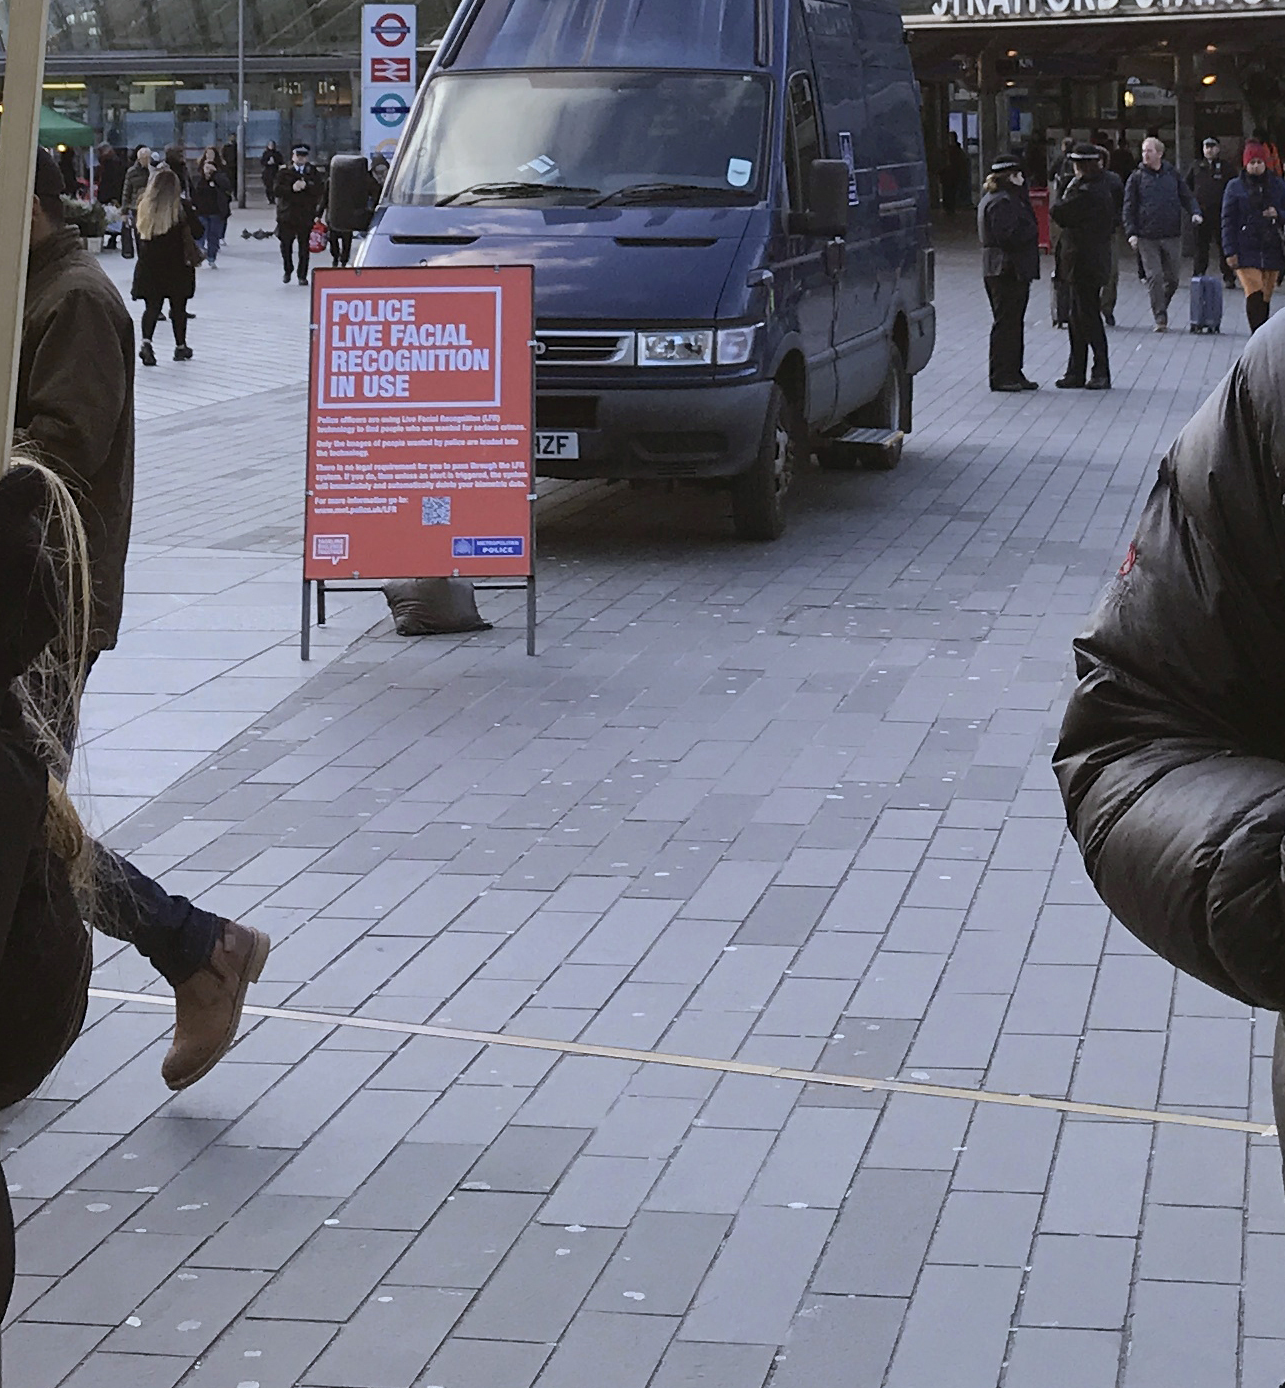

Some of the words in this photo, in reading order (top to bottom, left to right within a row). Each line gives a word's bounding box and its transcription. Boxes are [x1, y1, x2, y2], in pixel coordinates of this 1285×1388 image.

[332, 299, 416, 323] POLICE
[332, 324, 383, 348] LIVE
[390, 323, 473, 347] FACIAL
[331, 348, 490, 373] RECOGNITION
[330, 375, 355, 398] IN
[363, 374, 410, 398] USE
